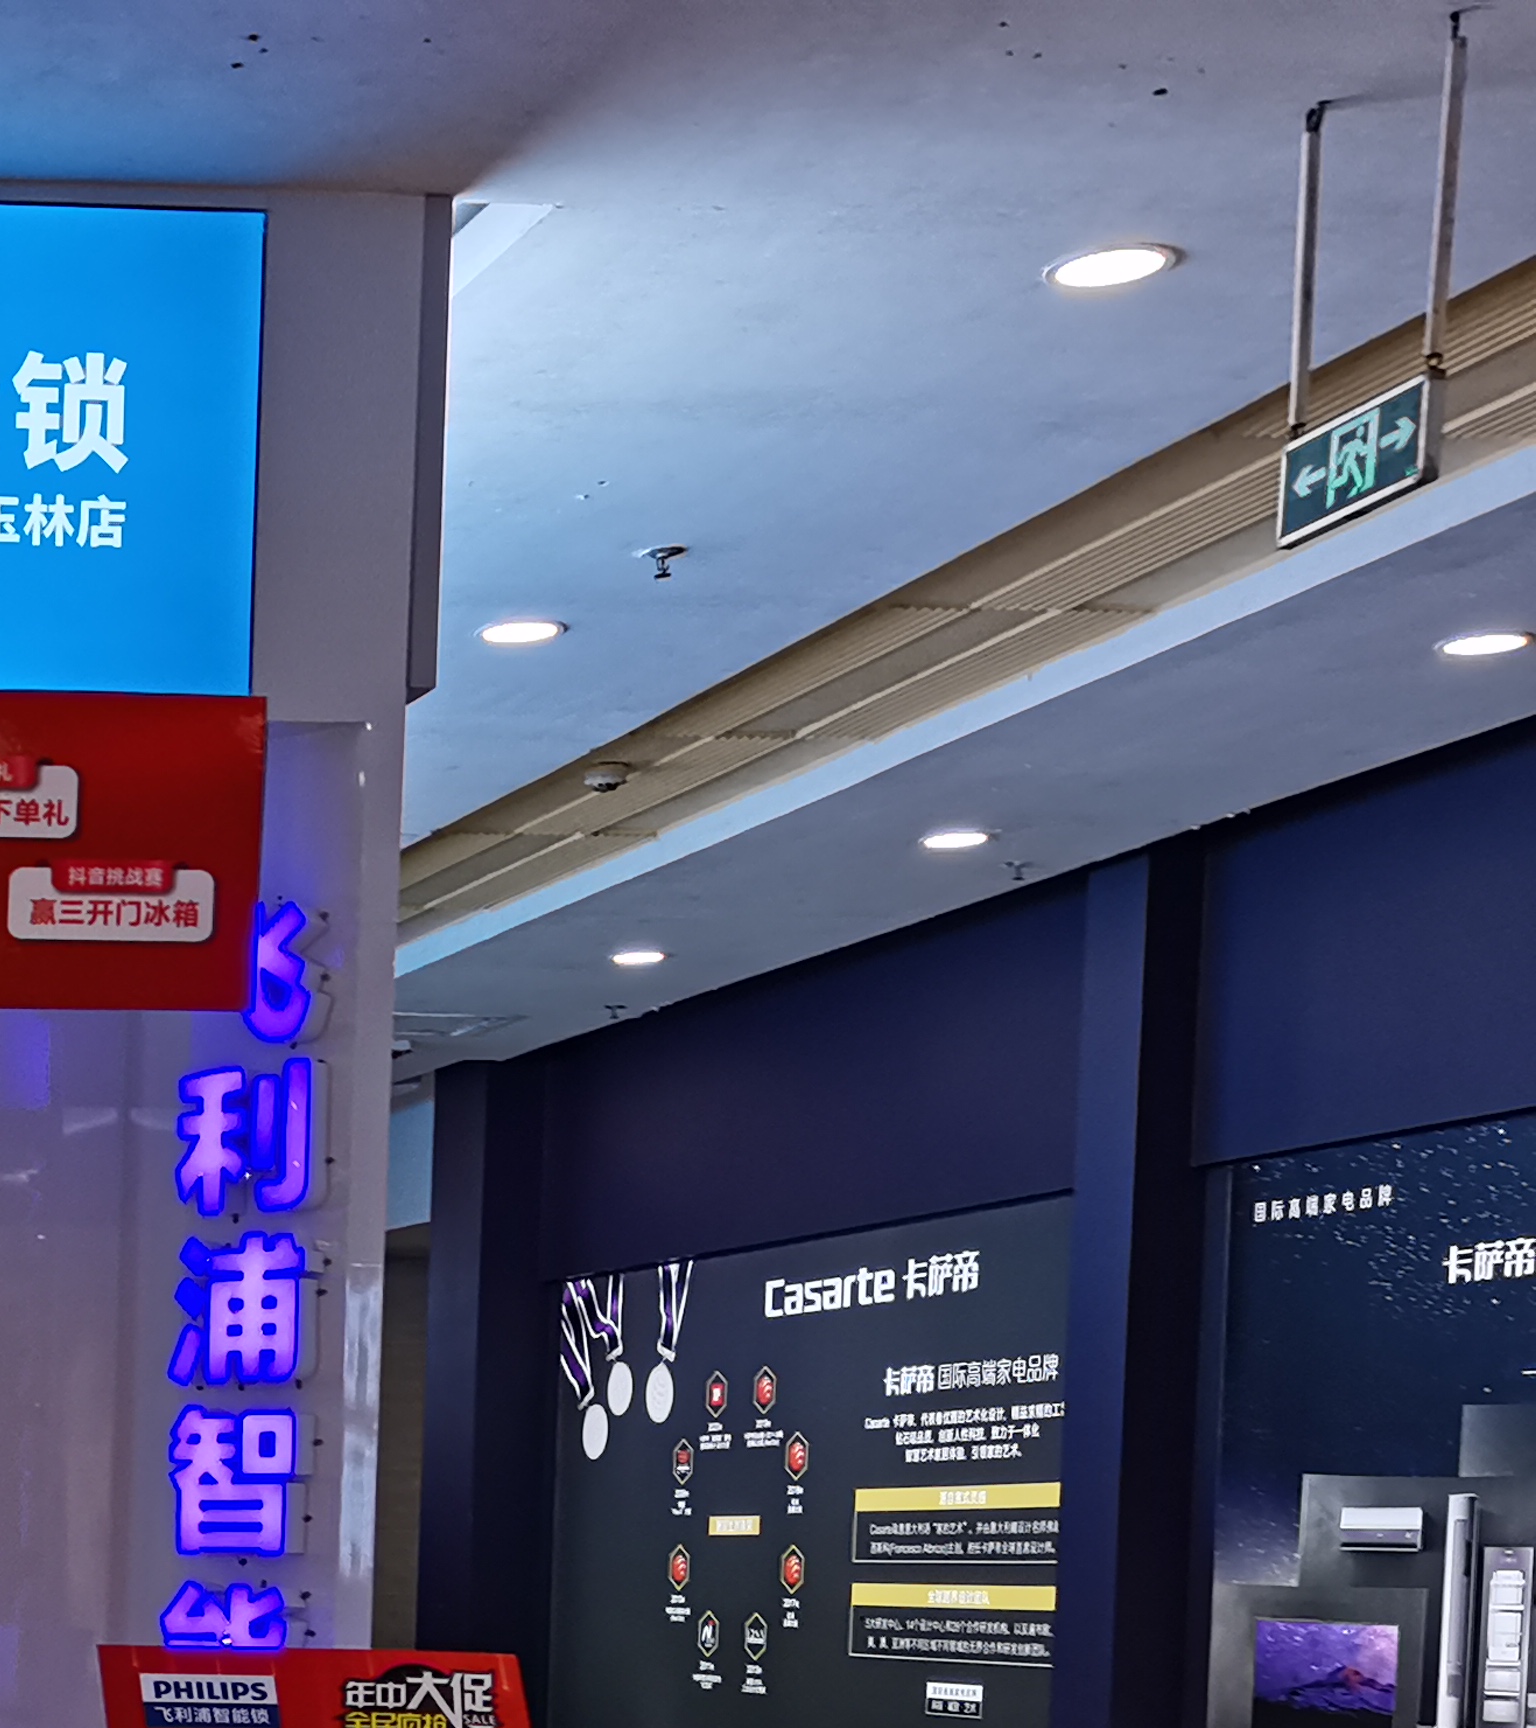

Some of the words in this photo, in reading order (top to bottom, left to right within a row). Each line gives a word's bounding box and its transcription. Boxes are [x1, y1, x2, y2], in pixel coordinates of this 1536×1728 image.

[68, 867, 165, 888] 抖音挑战赛
[30, 898, 200, 928] 赢三开门冰箱
[1441, 1238, 1536, 1285] 卡萨帝
[764, 1266, 896, 1318] Casarte
[902, 1250, 981, 1300] 卡萨帝
[153, 1680, 269, 1701] PHILIPS
[154, 1706, 271, 1725] 飞利浦智能锁
[462, 1713, 496, 1725] SALE
